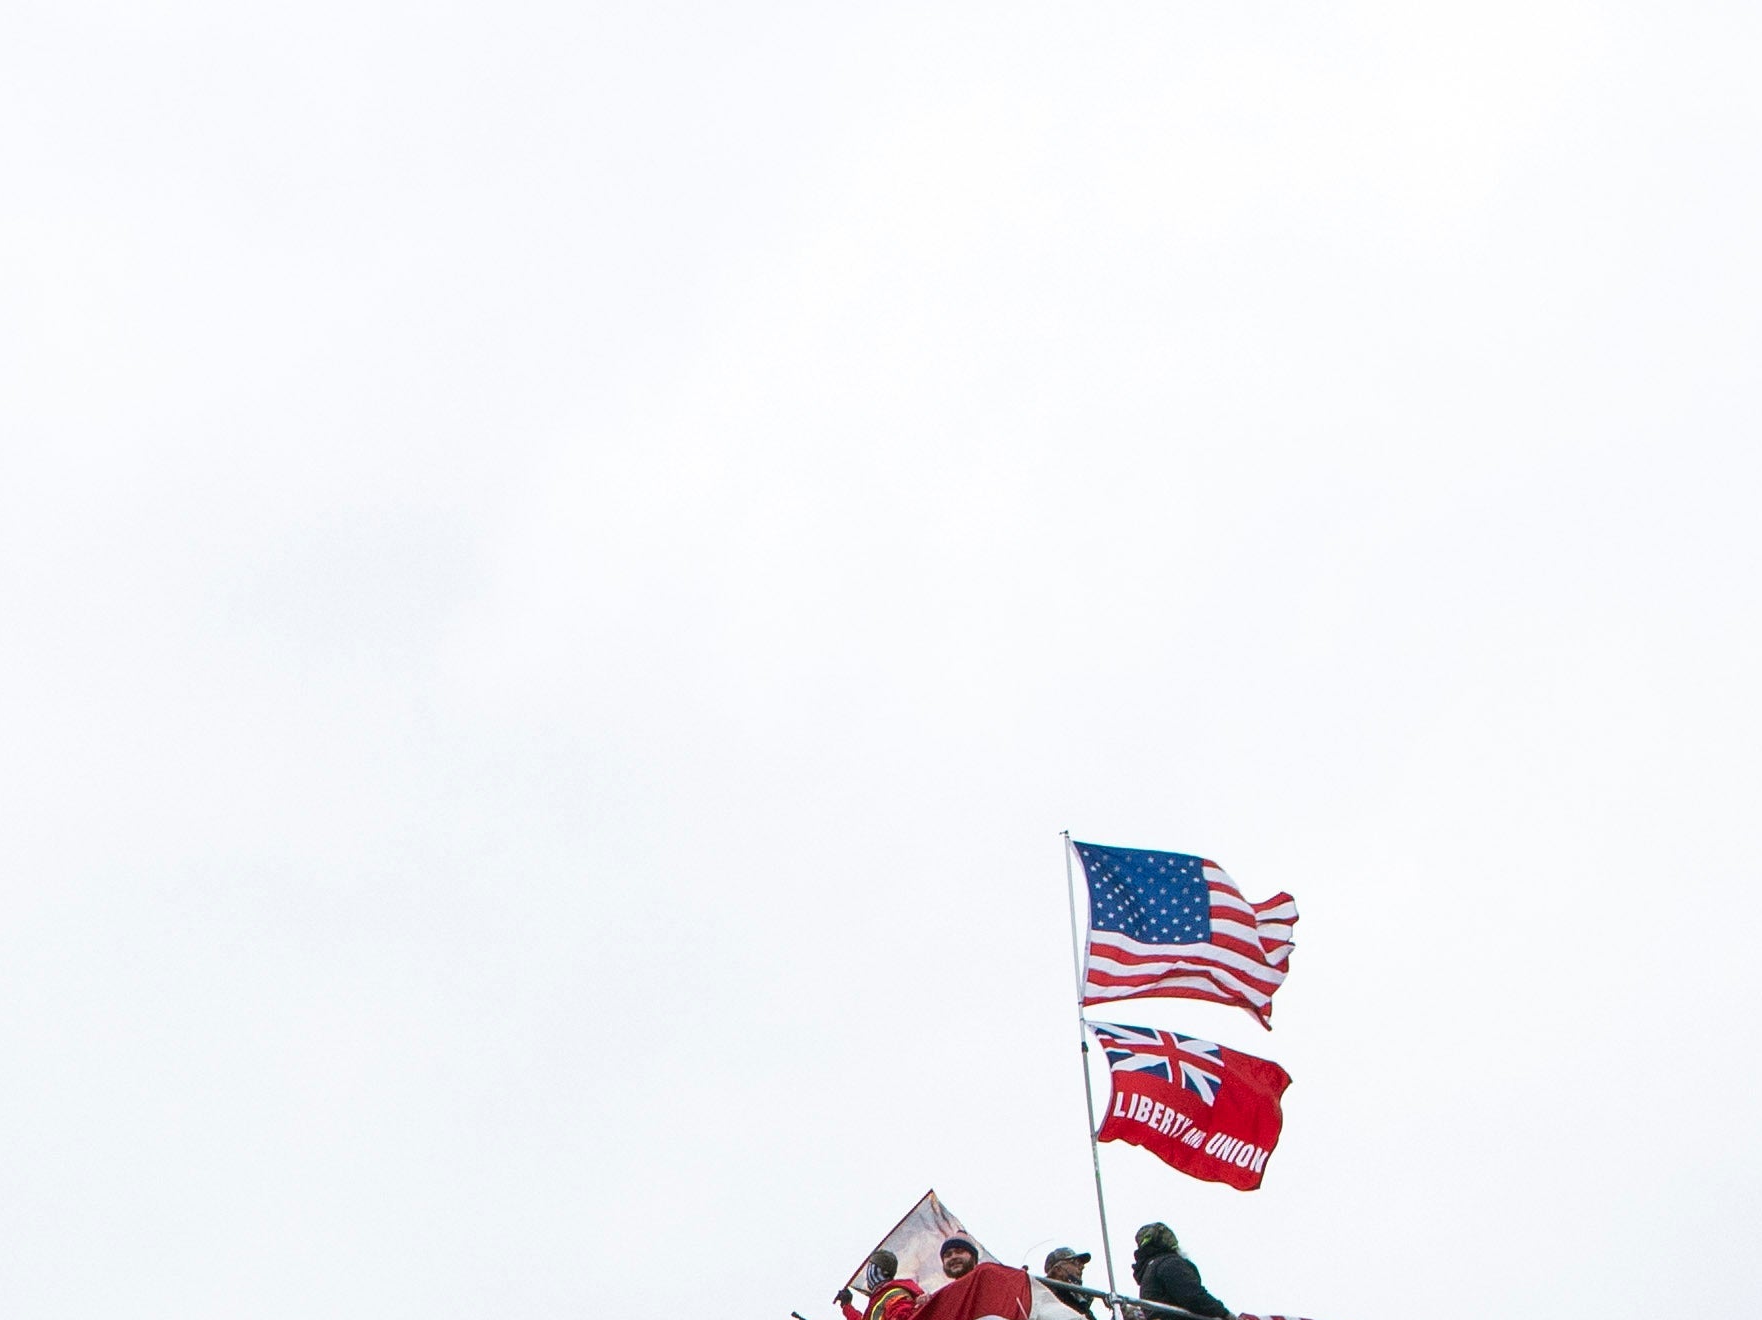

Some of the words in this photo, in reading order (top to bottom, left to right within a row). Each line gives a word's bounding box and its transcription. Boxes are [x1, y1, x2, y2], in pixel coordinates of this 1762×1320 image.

[1113, 1092, 1188, 1138] LIBERTY
[1182, 1123, 1204, 1149] AND
[1205, 1132, 1267, 1174] UNION
